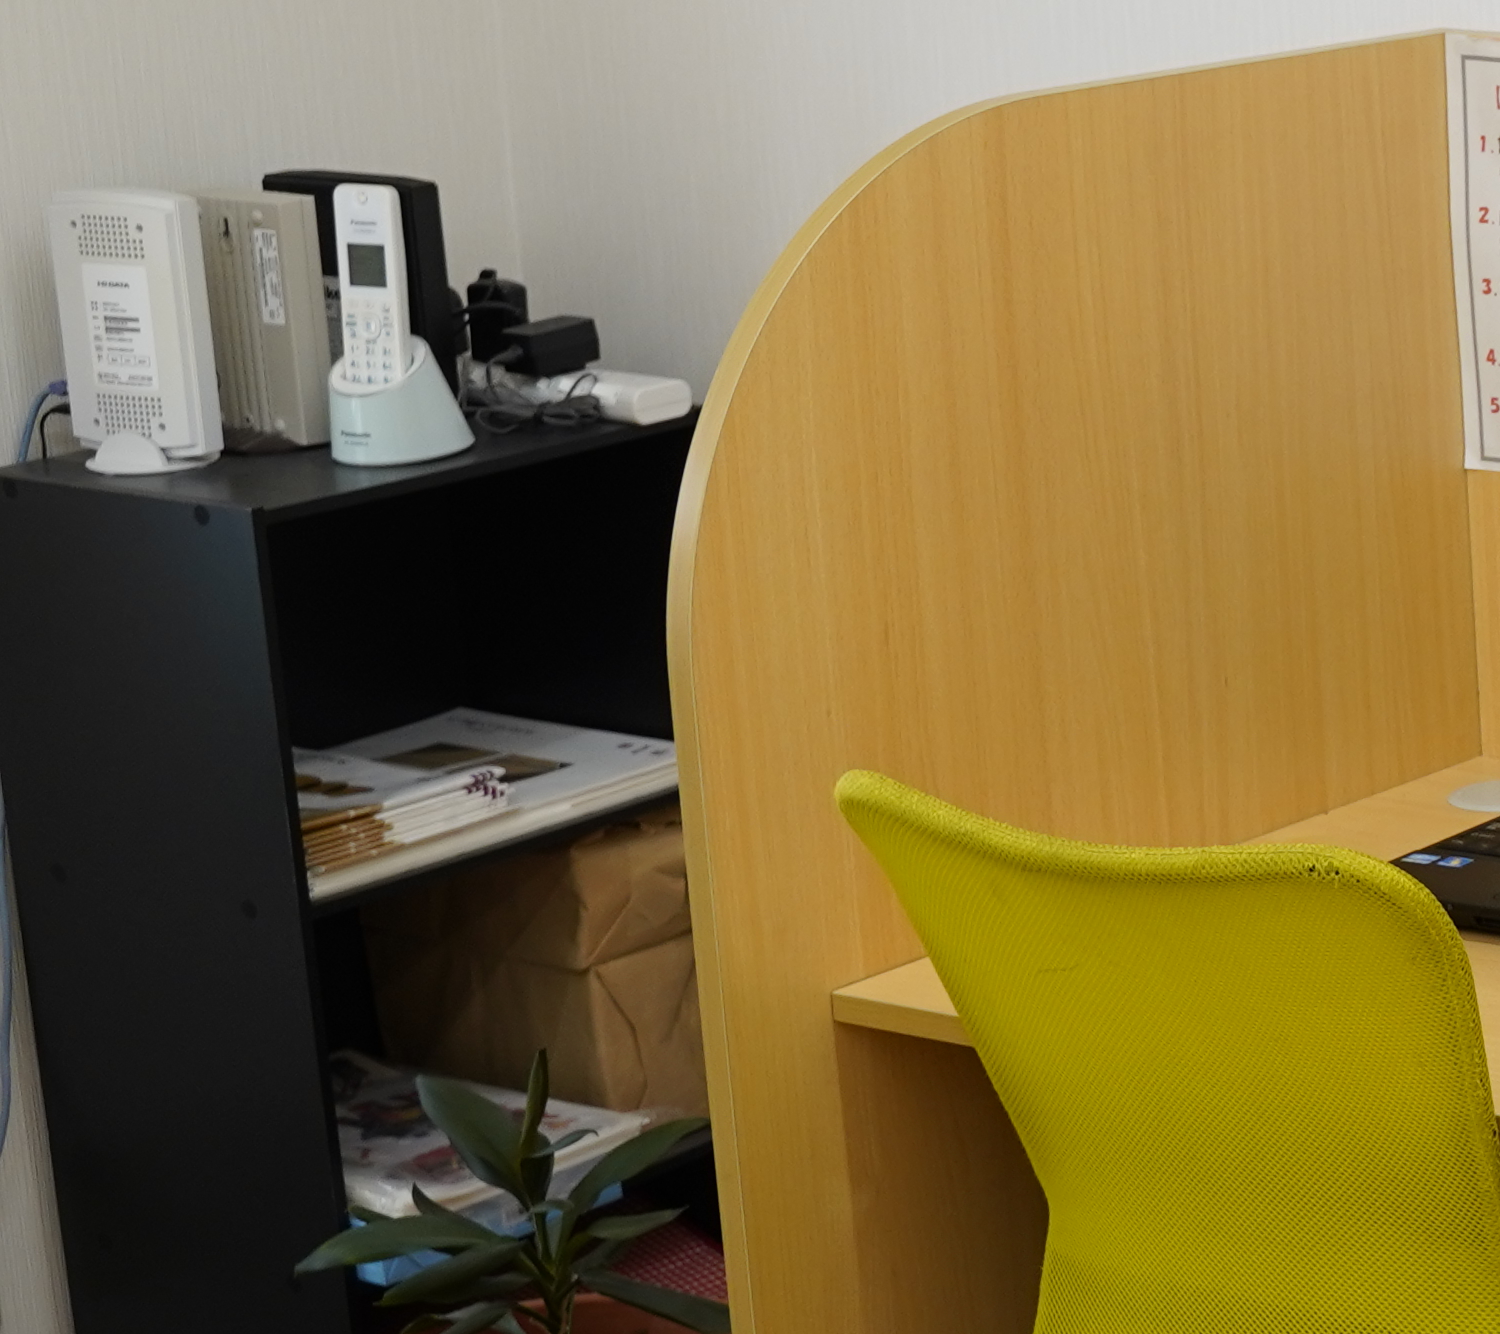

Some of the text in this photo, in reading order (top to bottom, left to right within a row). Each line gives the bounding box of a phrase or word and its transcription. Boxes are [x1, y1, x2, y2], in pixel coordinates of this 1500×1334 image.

[1479, 135, 1495, 154] 1.
[1478, 206, 1495, 226] 2.
[1481, 278, 1498, 297] 3.
[1486, 348, 1500, 367] 4.
